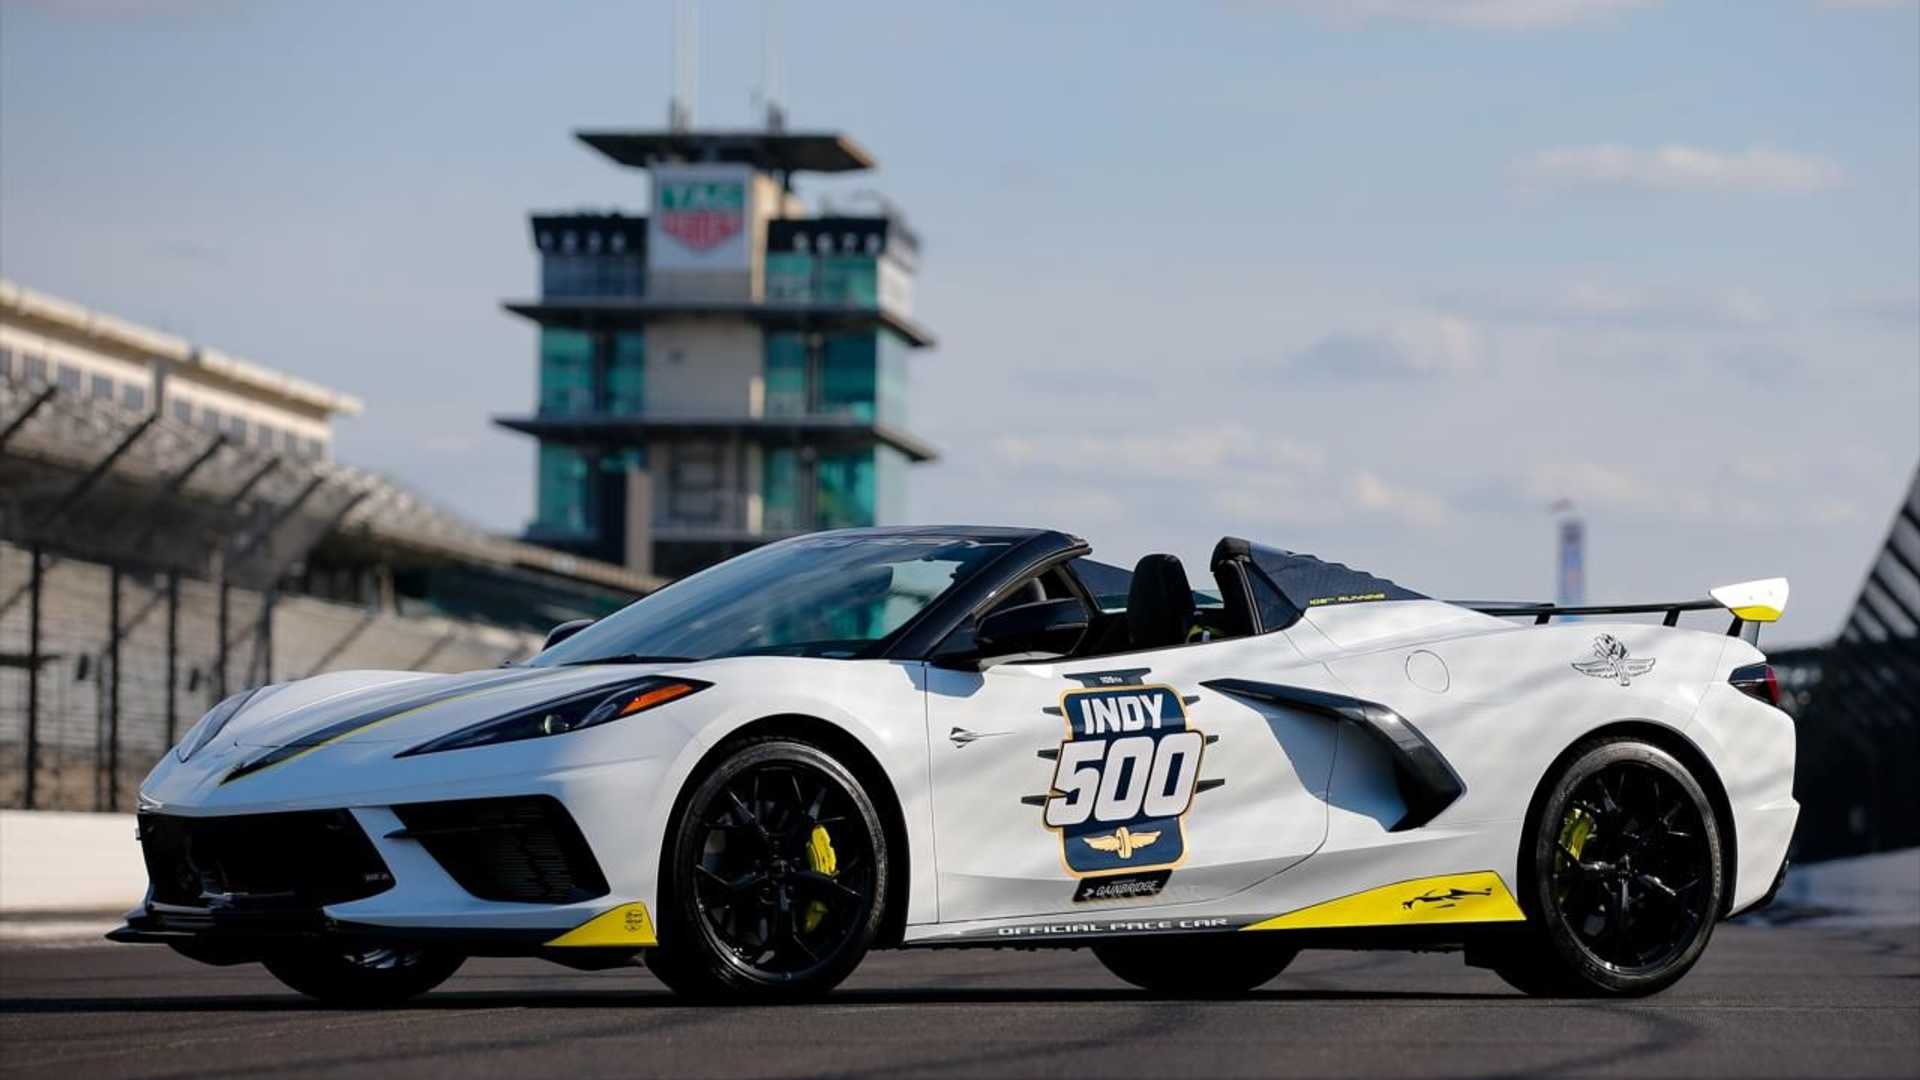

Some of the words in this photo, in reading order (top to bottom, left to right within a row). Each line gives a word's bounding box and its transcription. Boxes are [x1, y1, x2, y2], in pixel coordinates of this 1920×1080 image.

[1080, 694, 1164, 735] INDY
[1046, 731, 1202, 827] 500
[1096, 880, 1158, 897] GAINBRIDGE
[998, 924, 1103, 936] OFFICIAL
[1110, 920, 1172, 931] PACE
[1179, 918, 1228, 929] CAR
